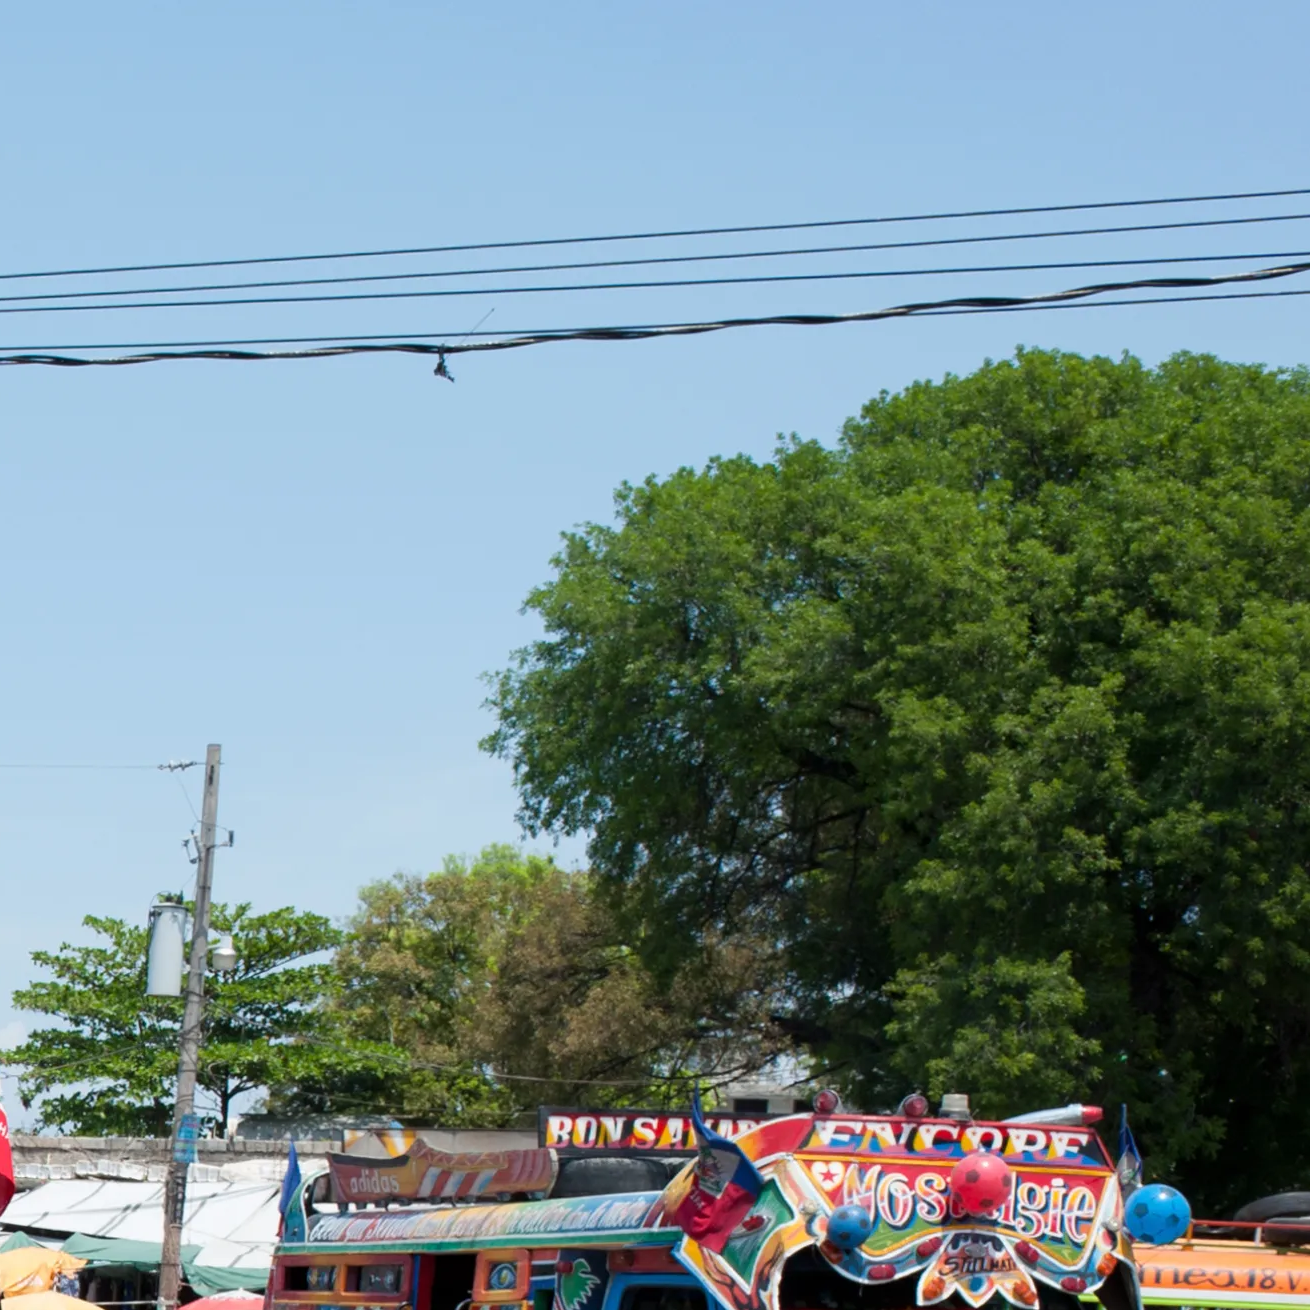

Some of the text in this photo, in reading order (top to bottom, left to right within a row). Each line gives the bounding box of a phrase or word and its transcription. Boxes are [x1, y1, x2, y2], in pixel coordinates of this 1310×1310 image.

[545, 1115, 627, 1148] BON
[804, 1119, 1091, 1162] ENCORE
[350, 1169, 400, 1193] adidas
[841, 1162, 1096, 1243] Noslgie
